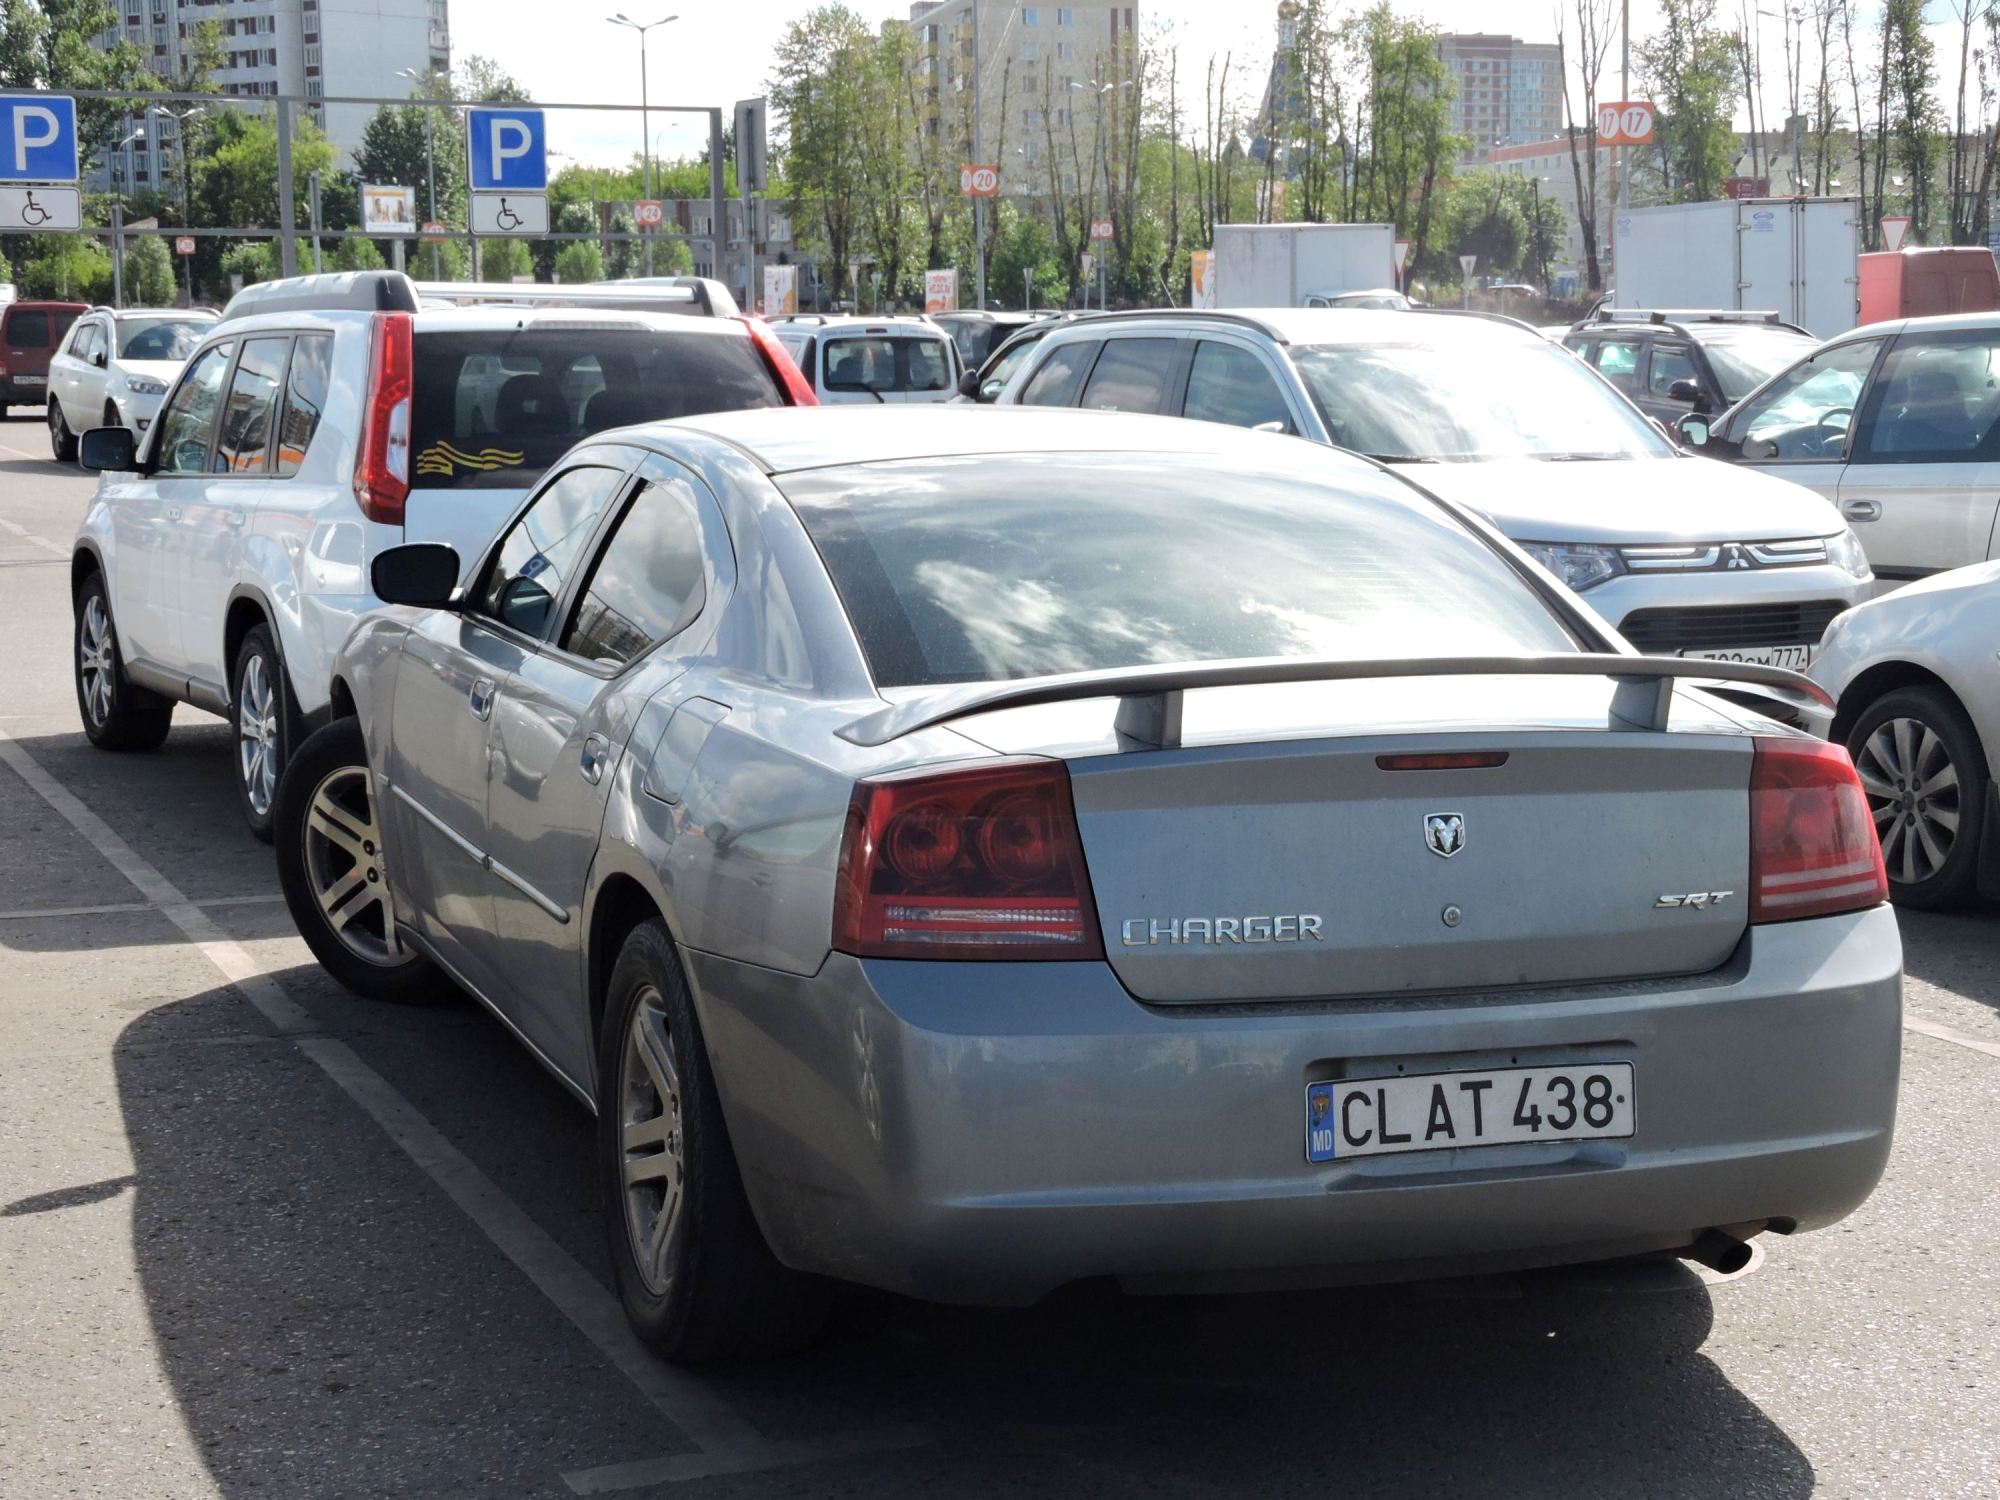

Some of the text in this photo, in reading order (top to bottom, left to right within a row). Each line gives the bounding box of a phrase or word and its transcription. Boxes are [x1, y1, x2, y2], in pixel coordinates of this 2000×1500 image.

[1602, 112, 1614, 134] 17
[1627, 111, 1645, 133] 17
[13, 106, 59, 170] P
[490, 119, 531, 180] P
[977, 172, 993, 188] 20
[646, 207, 659, 219] 24
[1655, 890, 1734, 910] SRT
[1122, 914, 1324, 946] CHARGER
[1342, 1074, 1614, 1147] CL AT 438
[1312, 1129, 1333, 1153] MD
